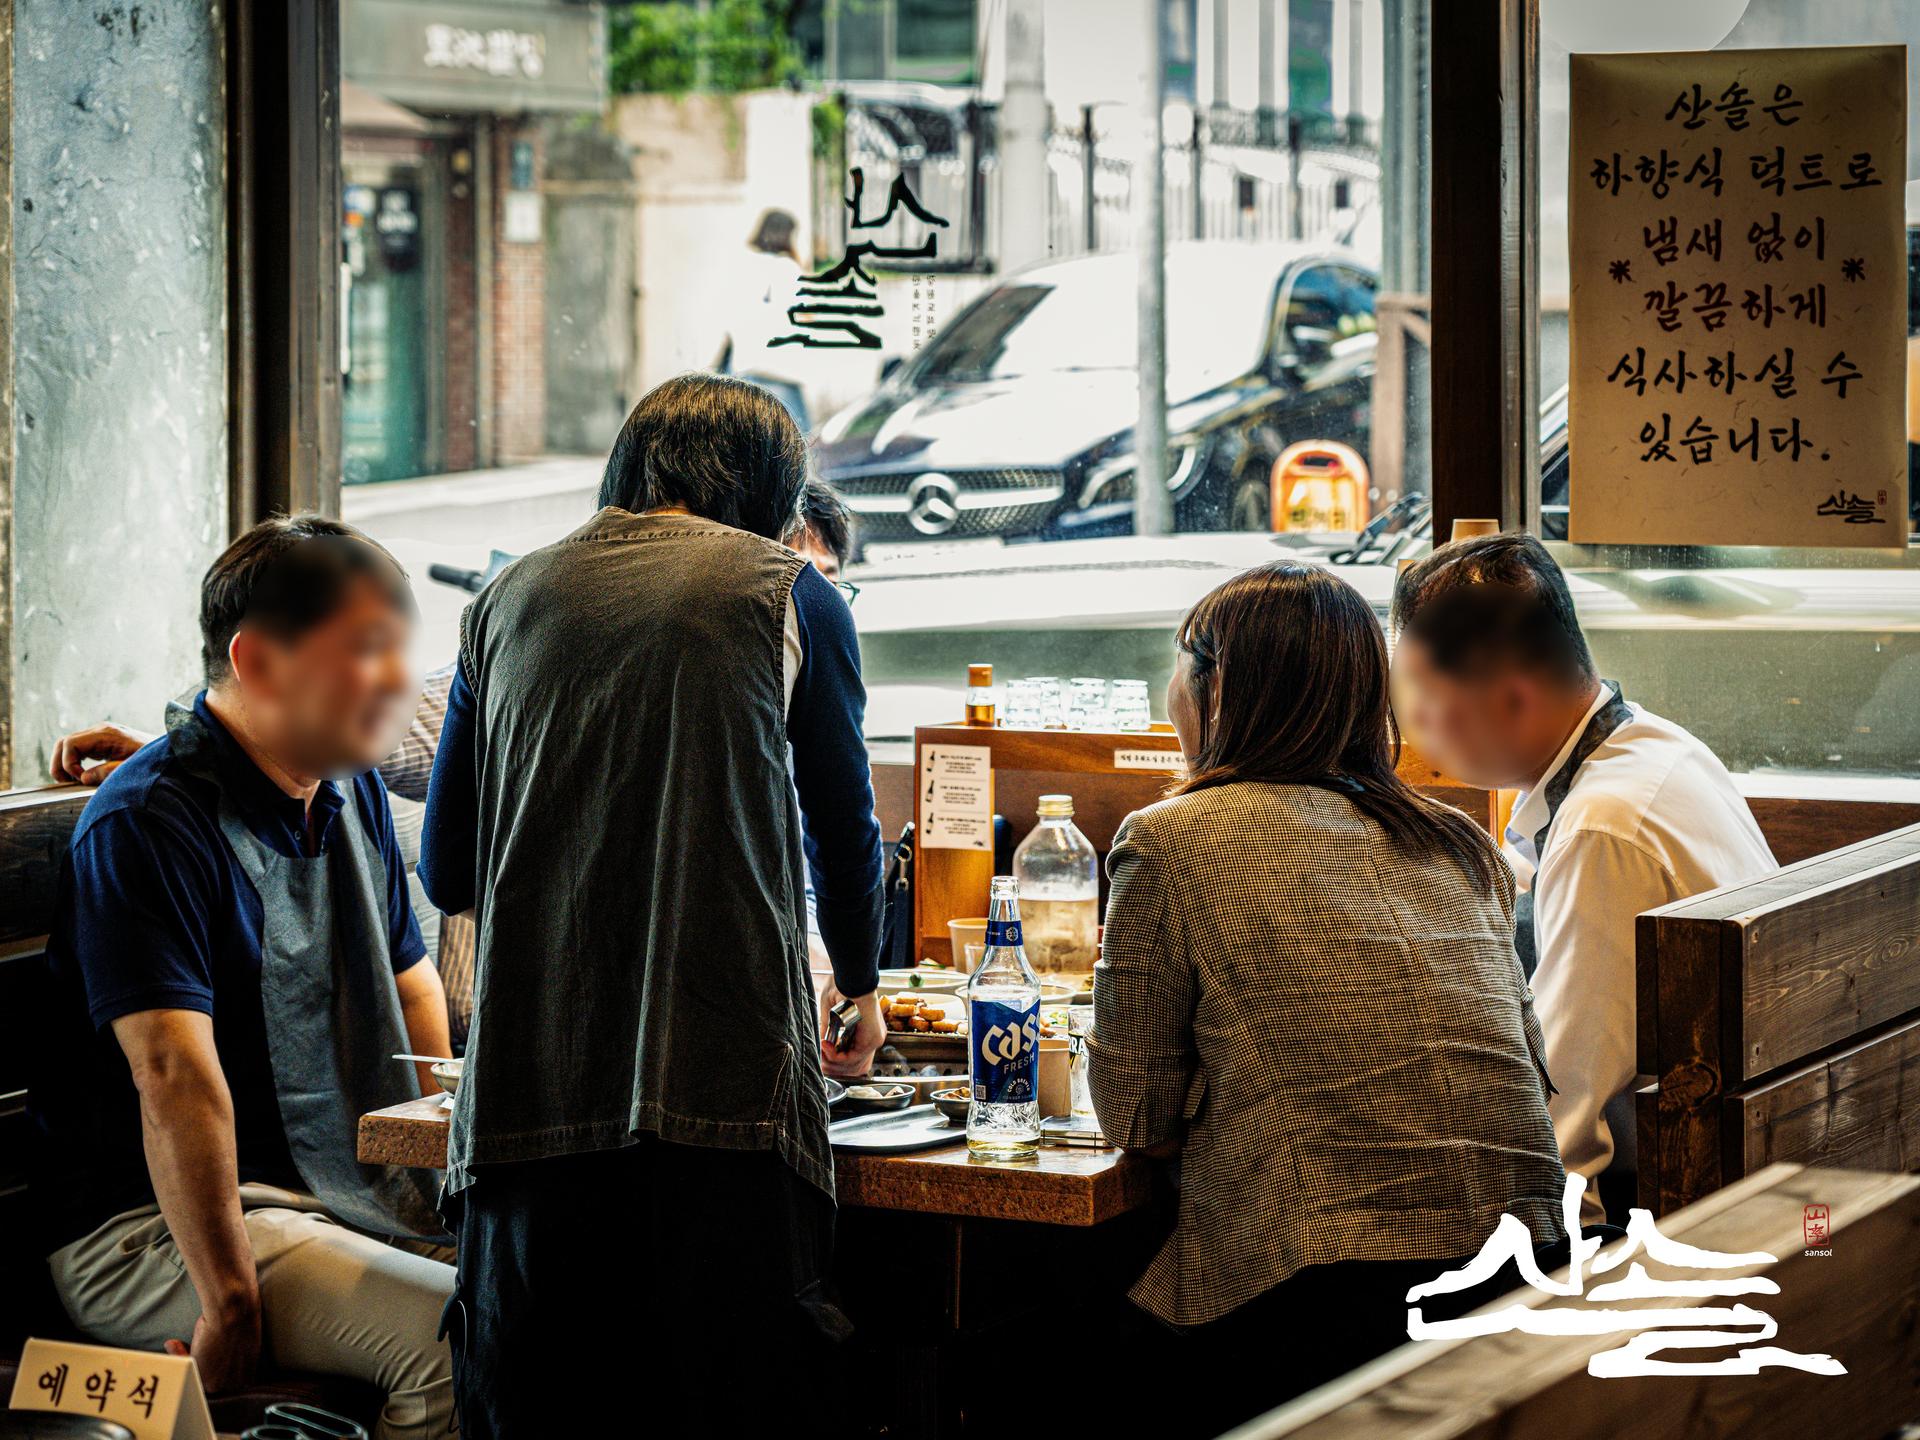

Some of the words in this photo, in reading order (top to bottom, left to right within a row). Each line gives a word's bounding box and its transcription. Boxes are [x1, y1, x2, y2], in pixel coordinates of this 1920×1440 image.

[1665, 81, 1804, 132] 산솔은
[1590, 146, 1724, 200] 하향식
[1749, 146, 1883, 197] 덕트로
[1642, 216, 1722, 264] 냄새
[1747, 211, 1826, 264] 없이
[1643, 281, 1827, 332] 깔끔하게
[1606, 347, 1799, 400] 식사하실
[1820, 351, 1864, 399] 수
[1639, 413, 1831, 466] 있습니다.
[981, 1013, 1040, 1066] Cas
[1003, 1052, 1035, 1074] FRESH
[38, 1363, 160, 1419] 예약석
